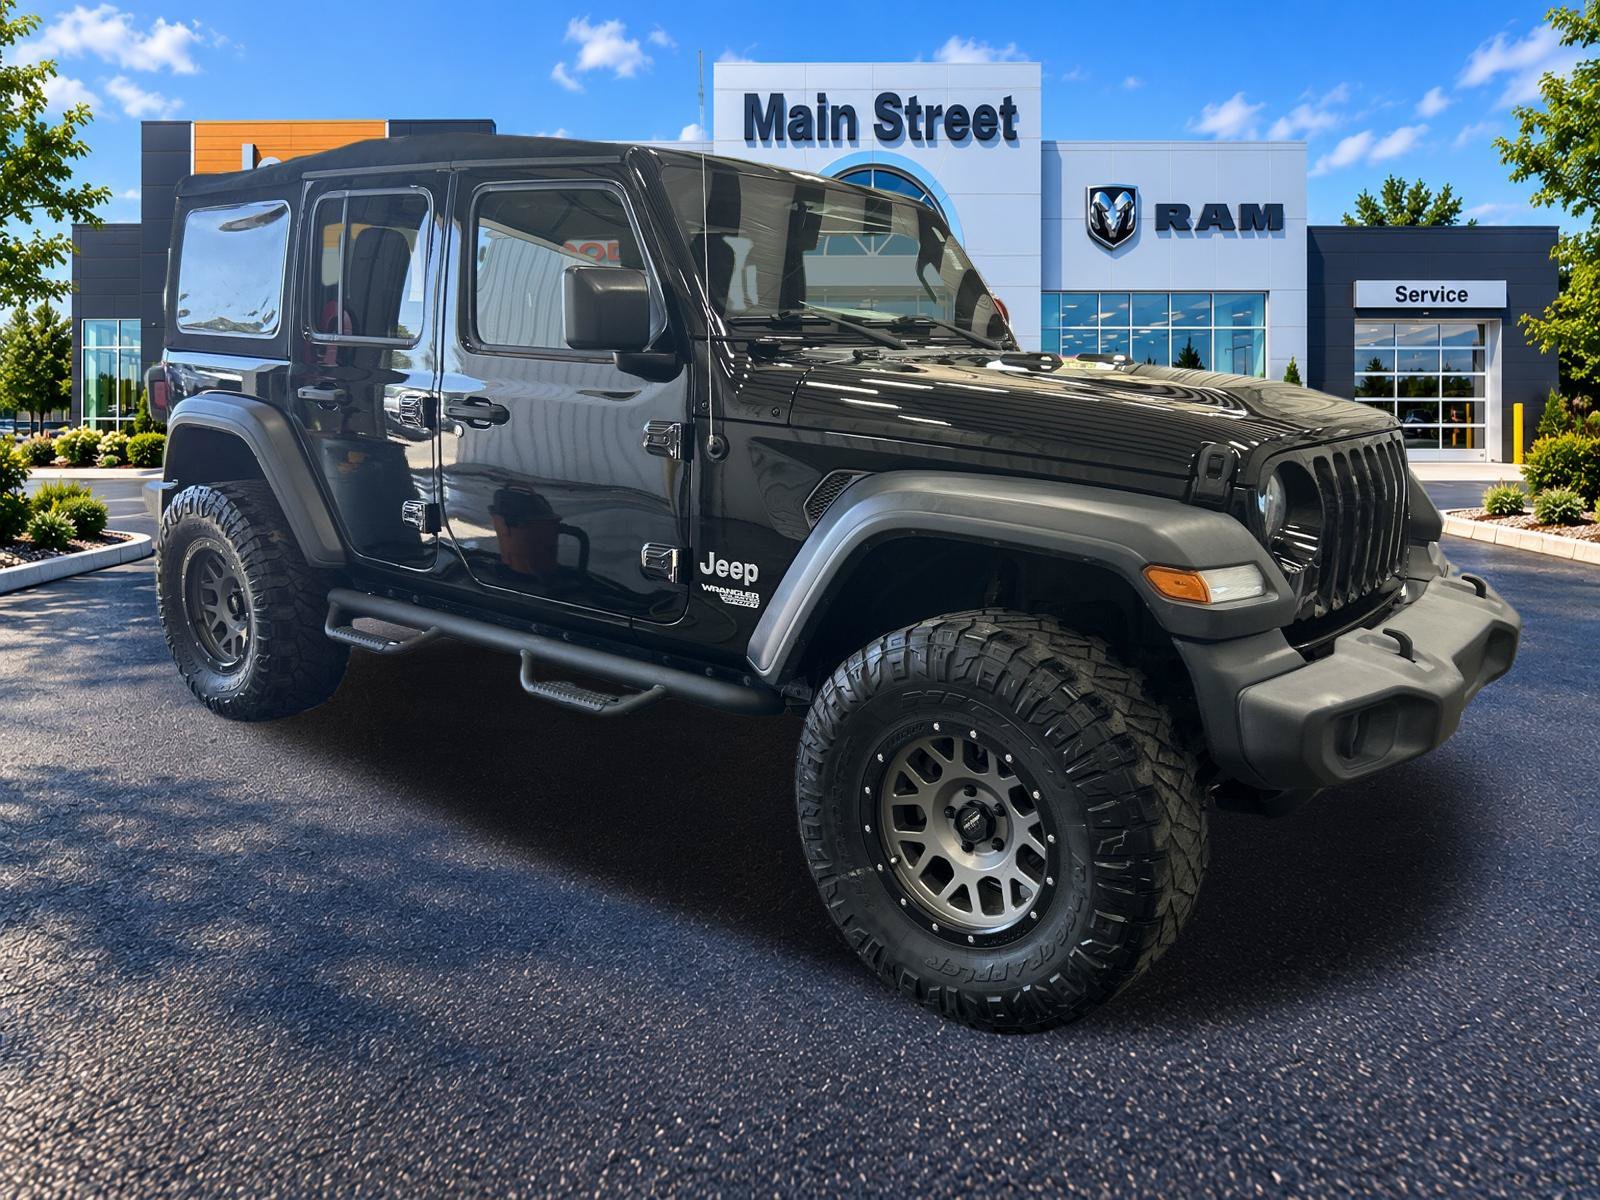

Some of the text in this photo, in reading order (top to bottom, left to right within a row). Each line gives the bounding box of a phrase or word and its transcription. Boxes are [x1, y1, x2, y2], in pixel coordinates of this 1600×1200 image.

[744, 91, 1018, 142] Main Street
[1155, 203, 1284, 231] RAM
[1395, 285, 1469, 303] Service
[699, 551, 759, 586] Jeep
[701, 583, 760, 599] WRANGLER
